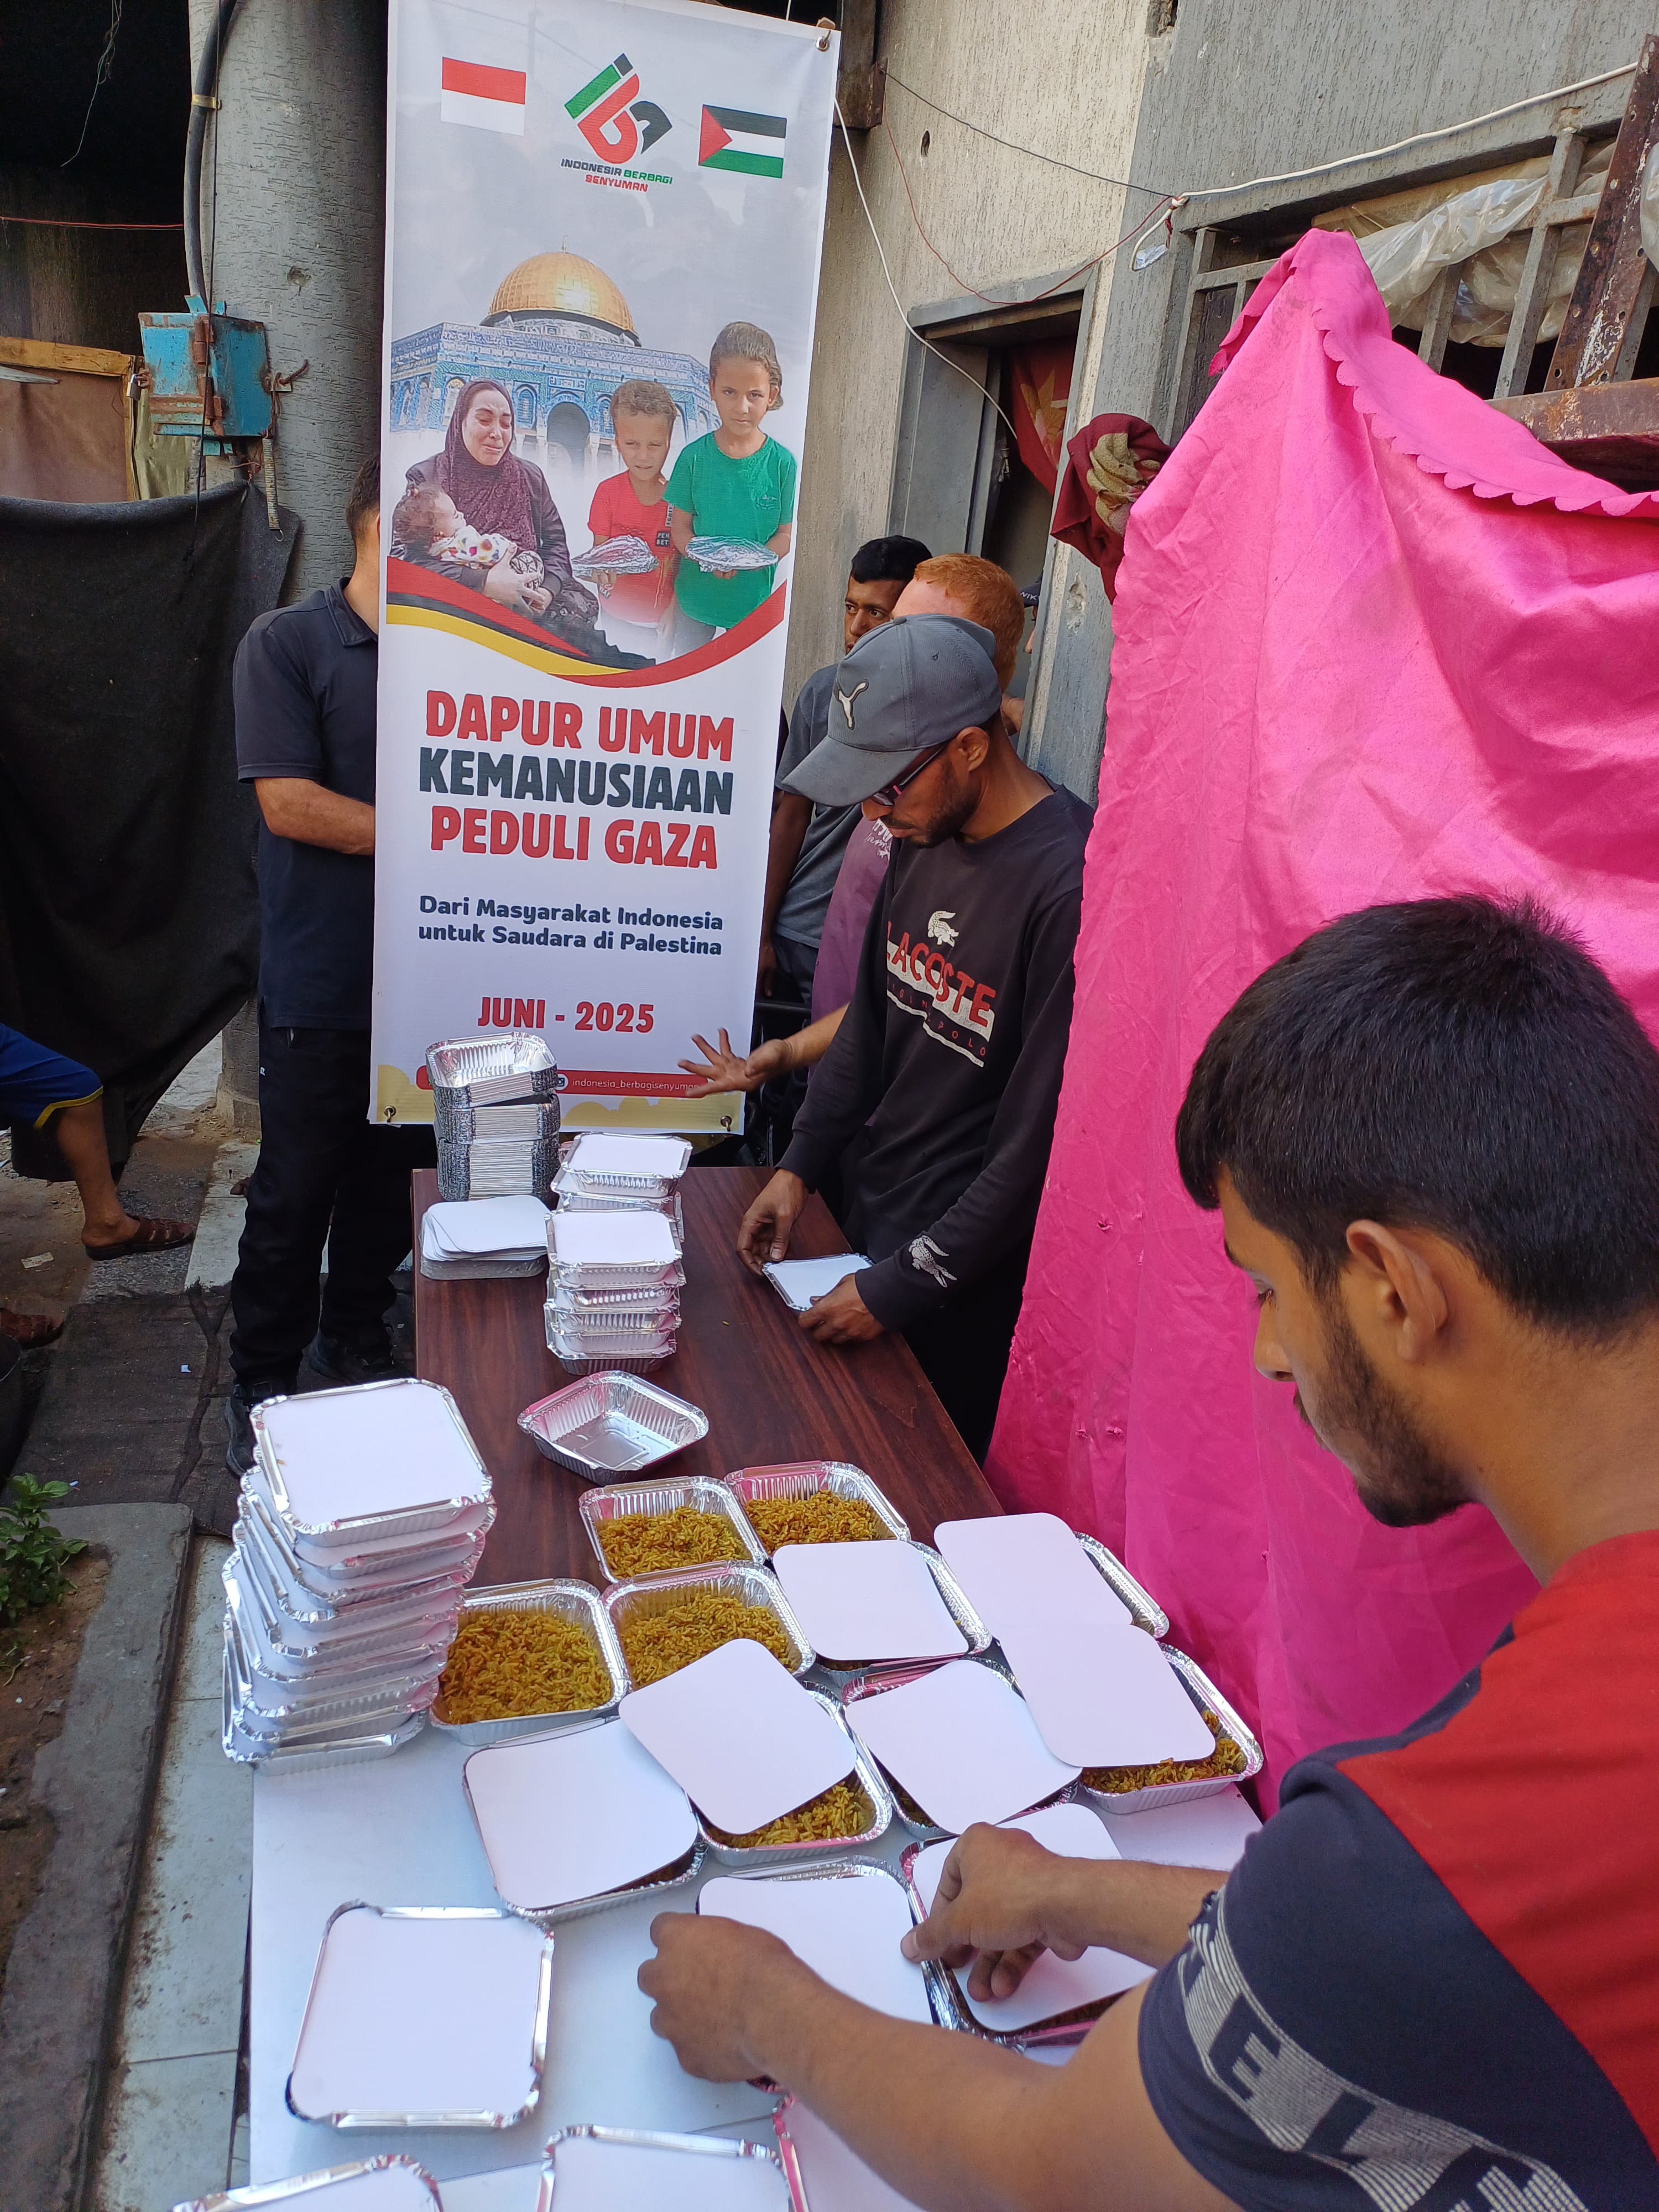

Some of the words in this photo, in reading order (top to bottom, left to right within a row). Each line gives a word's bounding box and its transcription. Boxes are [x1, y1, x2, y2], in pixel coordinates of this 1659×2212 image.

[561, 158, 622, 176] INDONESIA
[623, 169, 672, 185] BERBAGI
[585, 174, 648, 192] SENYUMAN
[1020, 592, 1039, 601] NIK
[426, 690, 583, 749] DAPUR
[599, 706, 734, 761] UMUM
[419, 747, 734, 815] KEMANUSIAAN
[431, 806, 591, 860] PEDULI
[605, 818, 717, 869] GAZA
[420, 895, 469, 915] Dari
[476, 899, 611, 924] Masyarakat
[618, 907, 723, 930] Indonesia
[419, 924, 486, 942] untuk
[492, 926, 586, 948] Saudara
[593, 931, 614, 950] di
[620, 933, 722, 955] Palestina
[478, 997, 546, 1029] JUNI
[575, 1001, 654, 1033] 2025
